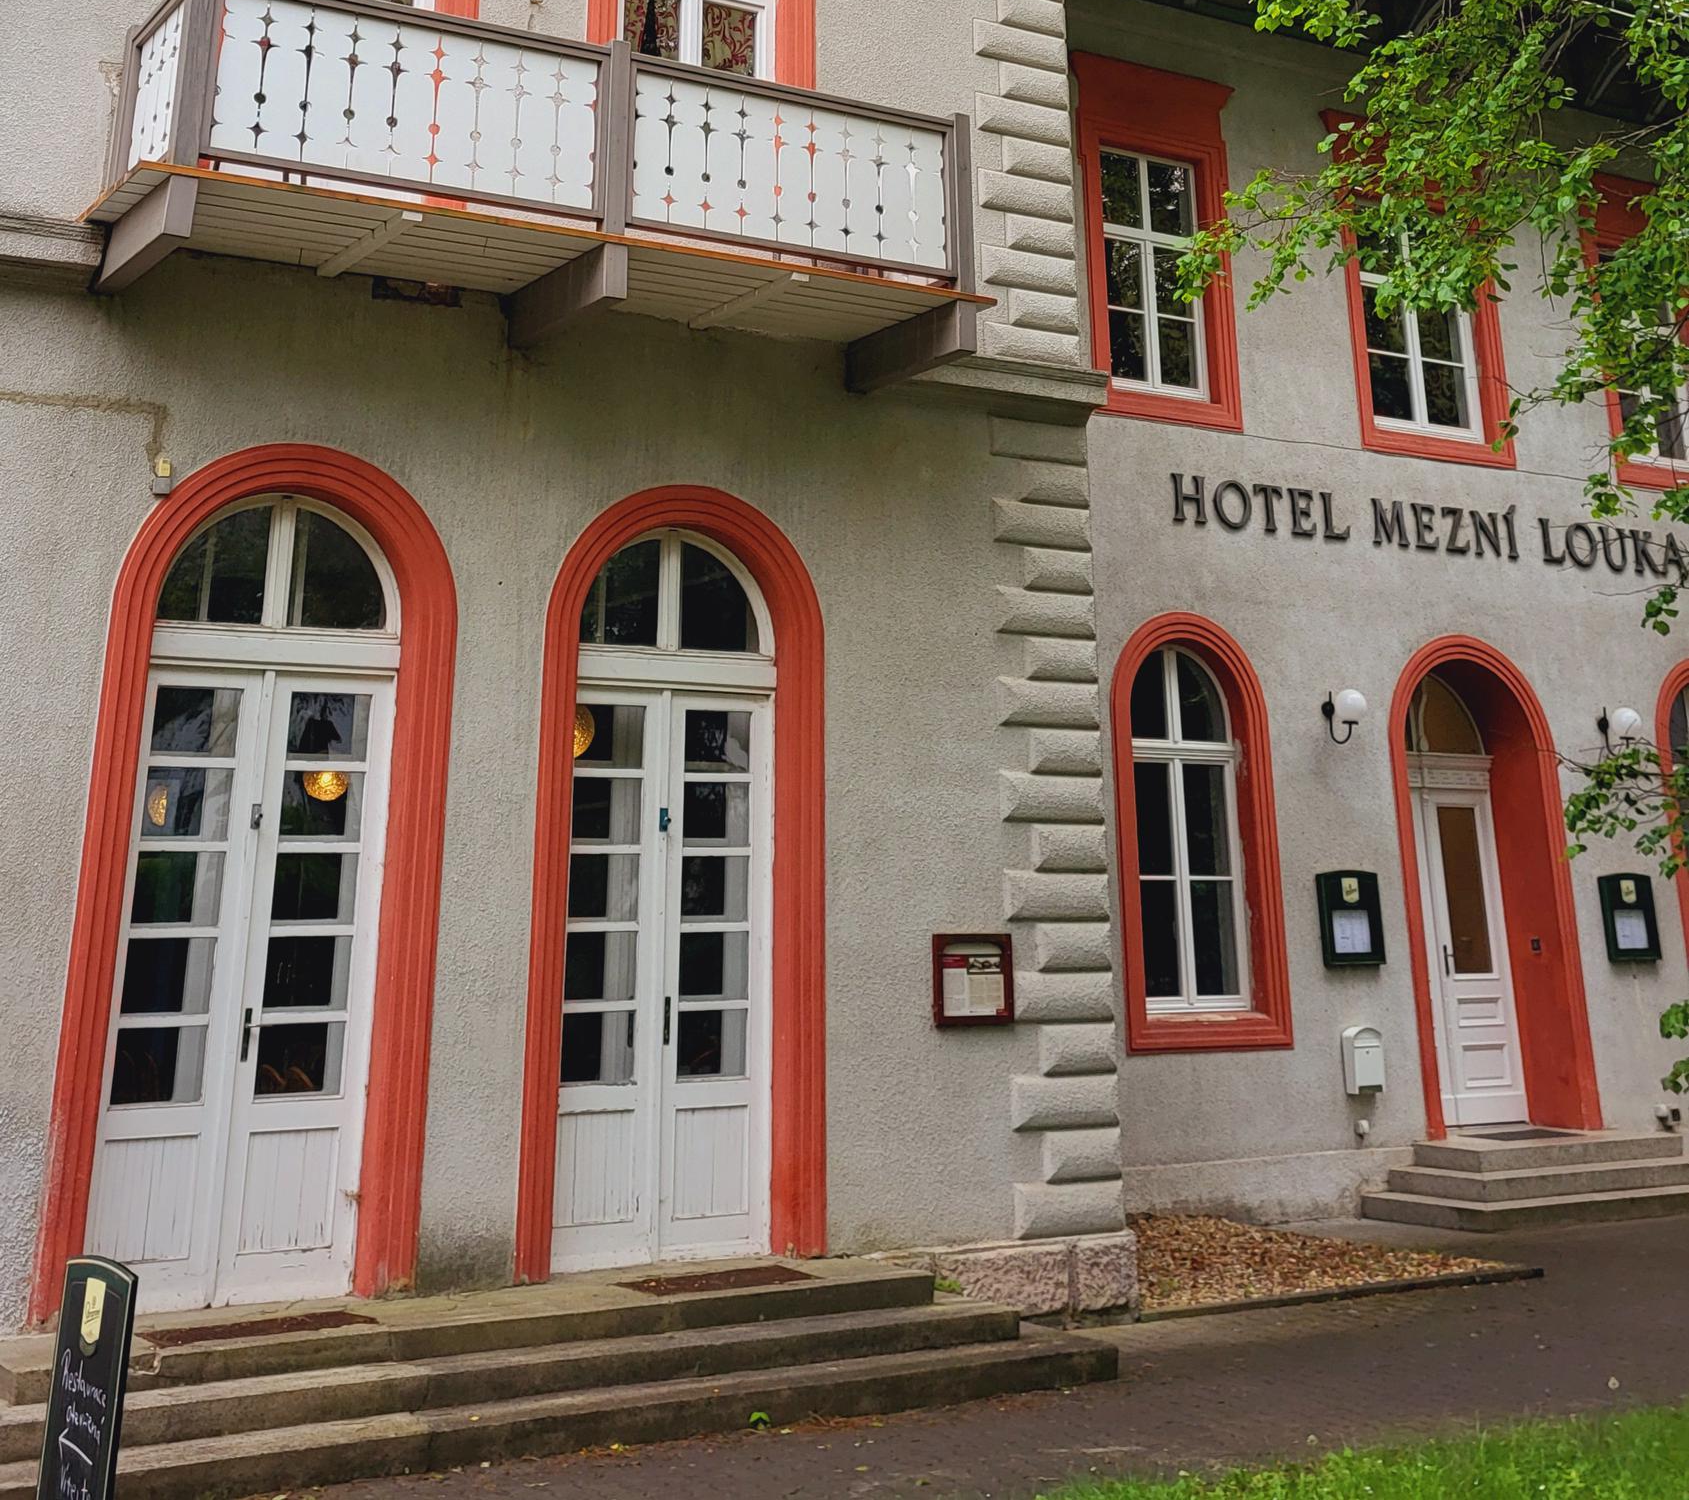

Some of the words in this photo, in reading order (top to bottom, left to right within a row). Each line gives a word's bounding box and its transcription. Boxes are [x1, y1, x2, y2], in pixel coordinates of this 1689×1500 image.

[1170, 473, 1350, 541] HOTEL
[1371, 498, 1519, 560] MEZNÍ
[1538, 518, 1688, 581] LOUKA
